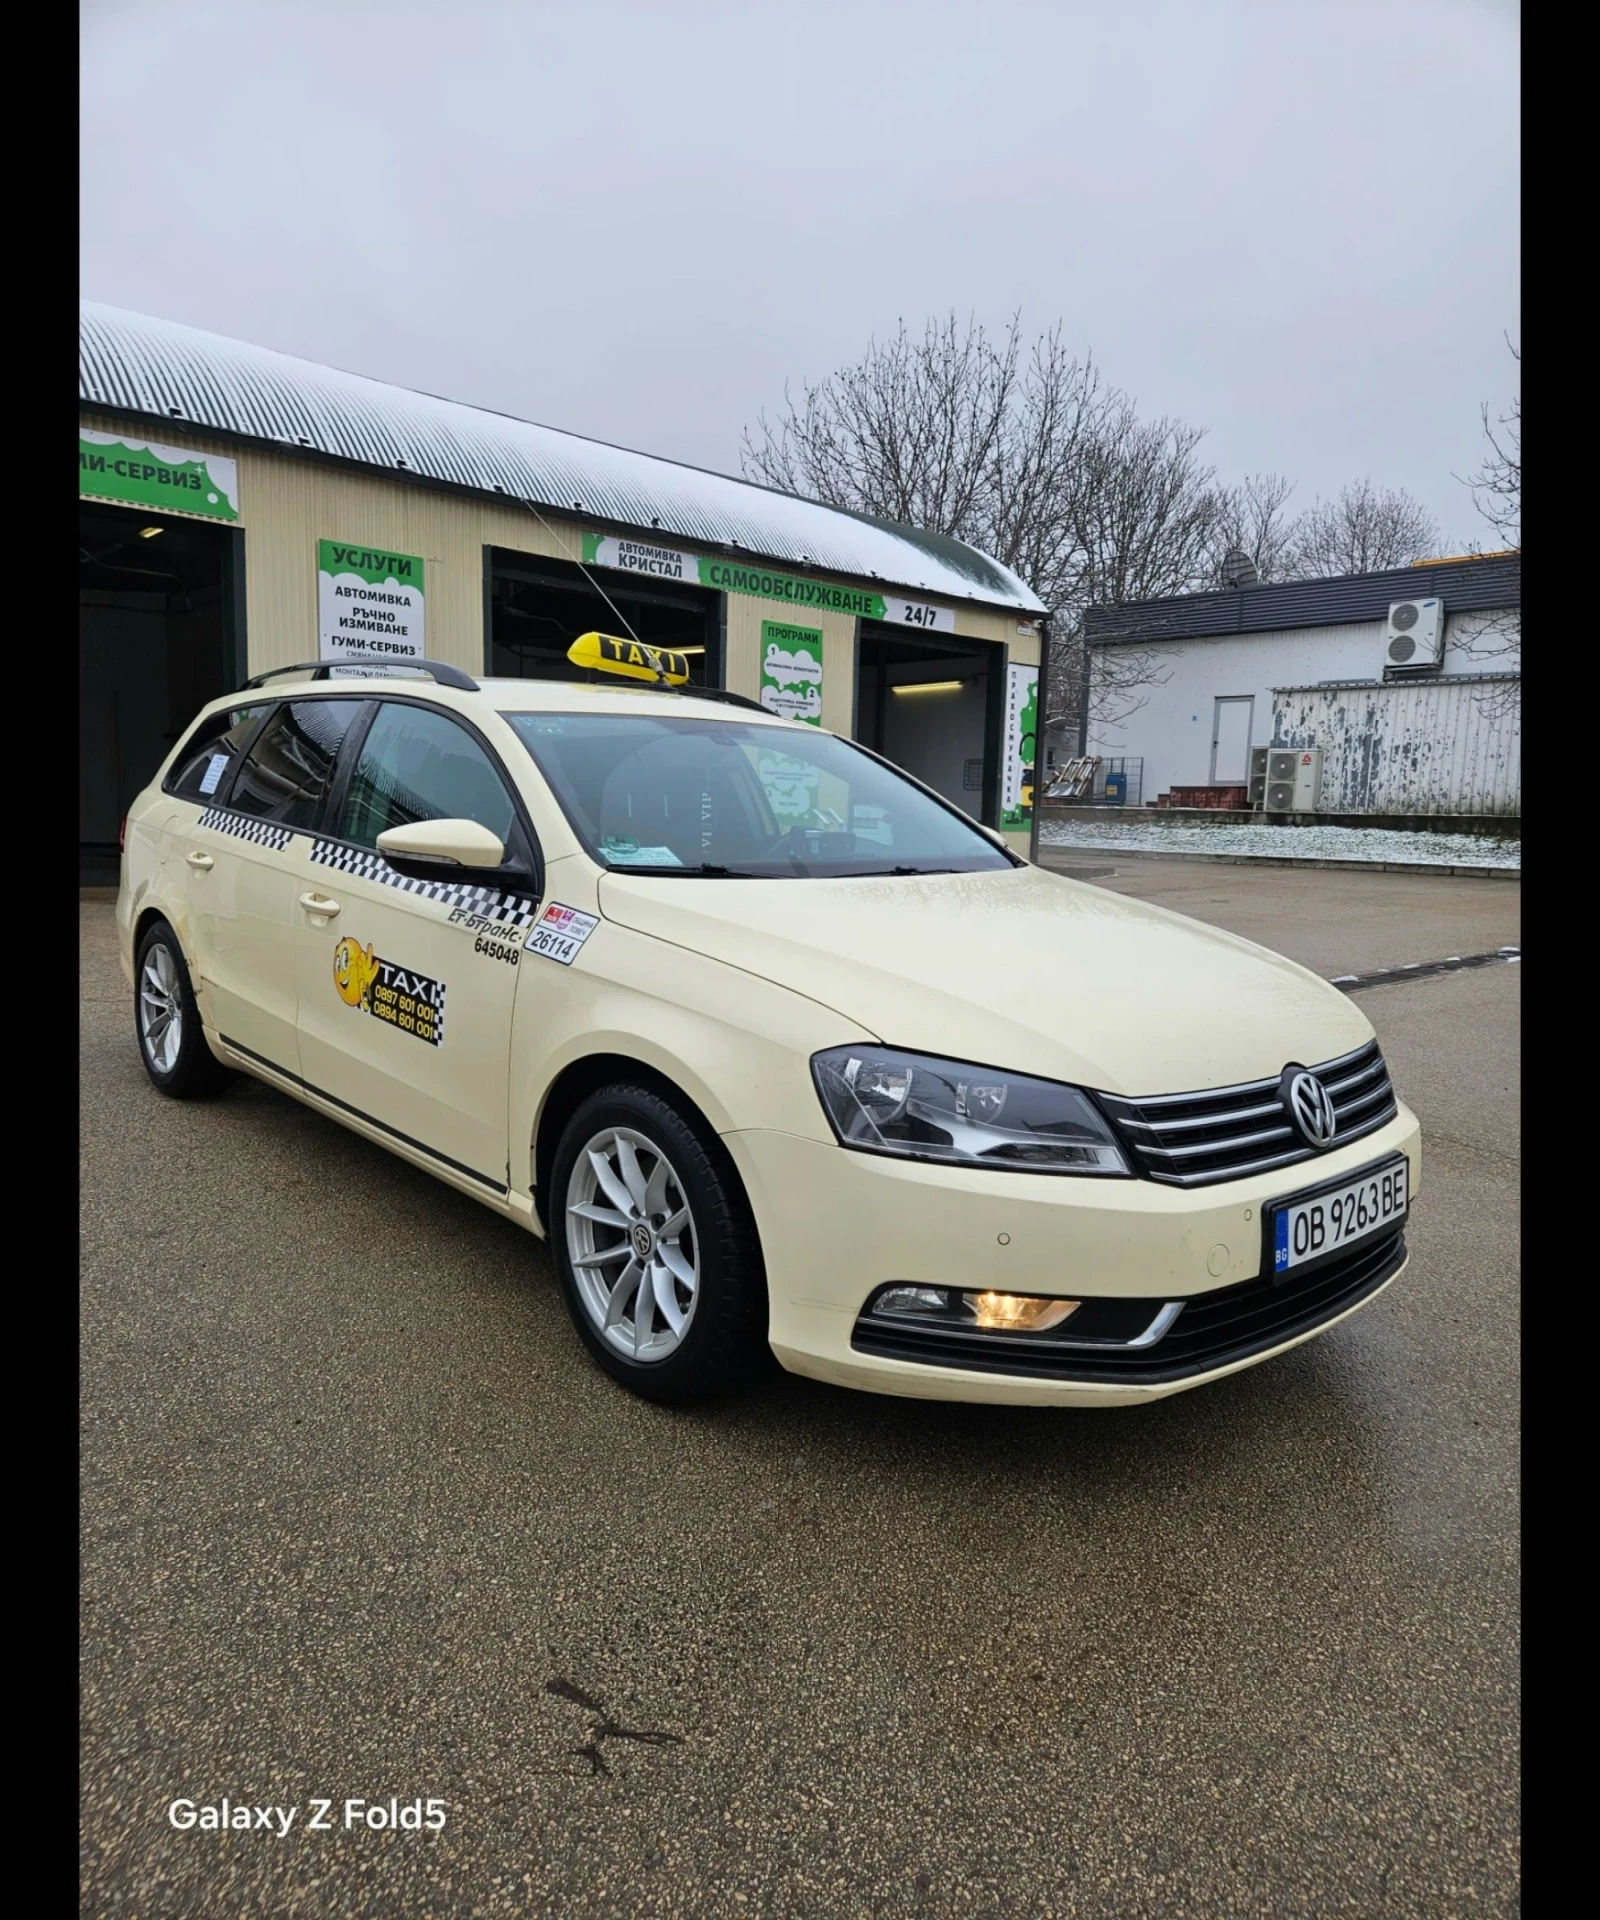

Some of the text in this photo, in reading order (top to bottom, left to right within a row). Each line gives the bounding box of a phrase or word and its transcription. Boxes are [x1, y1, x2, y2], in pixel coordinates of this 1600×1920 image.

[332, 546, 412, 577] УСЛУГИ
[618, 541, 682, 564] АВТОМИВКА
[618, 553, 682, 578] КРИСТАЛ
[335, 585, 412, 607] АВТОМИВКА
[709, 565, 872, 614] САМООБСЛУЖВАНЕ
[339, 616, 409, 636] ИЗМИВАНЕ
[352, 606, 396, 623] РЪЧНО
[904, 605, 937, 627] 24/7
[331, 635, 416, 656] ГУМИ-СЕРВИЗ
[767, 626, 819, 644] ПРОГРАМИ
[1006, 671, 1017, 804] ПРАХОСМУКАЧКА
[474, 937, 519, 966] 645048
[531, 931, 575, 958] 26114
[380, 963, 436, 1004] TAXI
[375, 985, 434, 1023] 0897 601 001
[374, 1001, 434, 1040] 0894 601 001
[1294, 1168, 1404, 1256] OB 9263 BE
[1275, 1248, 1288, 1264] BG
